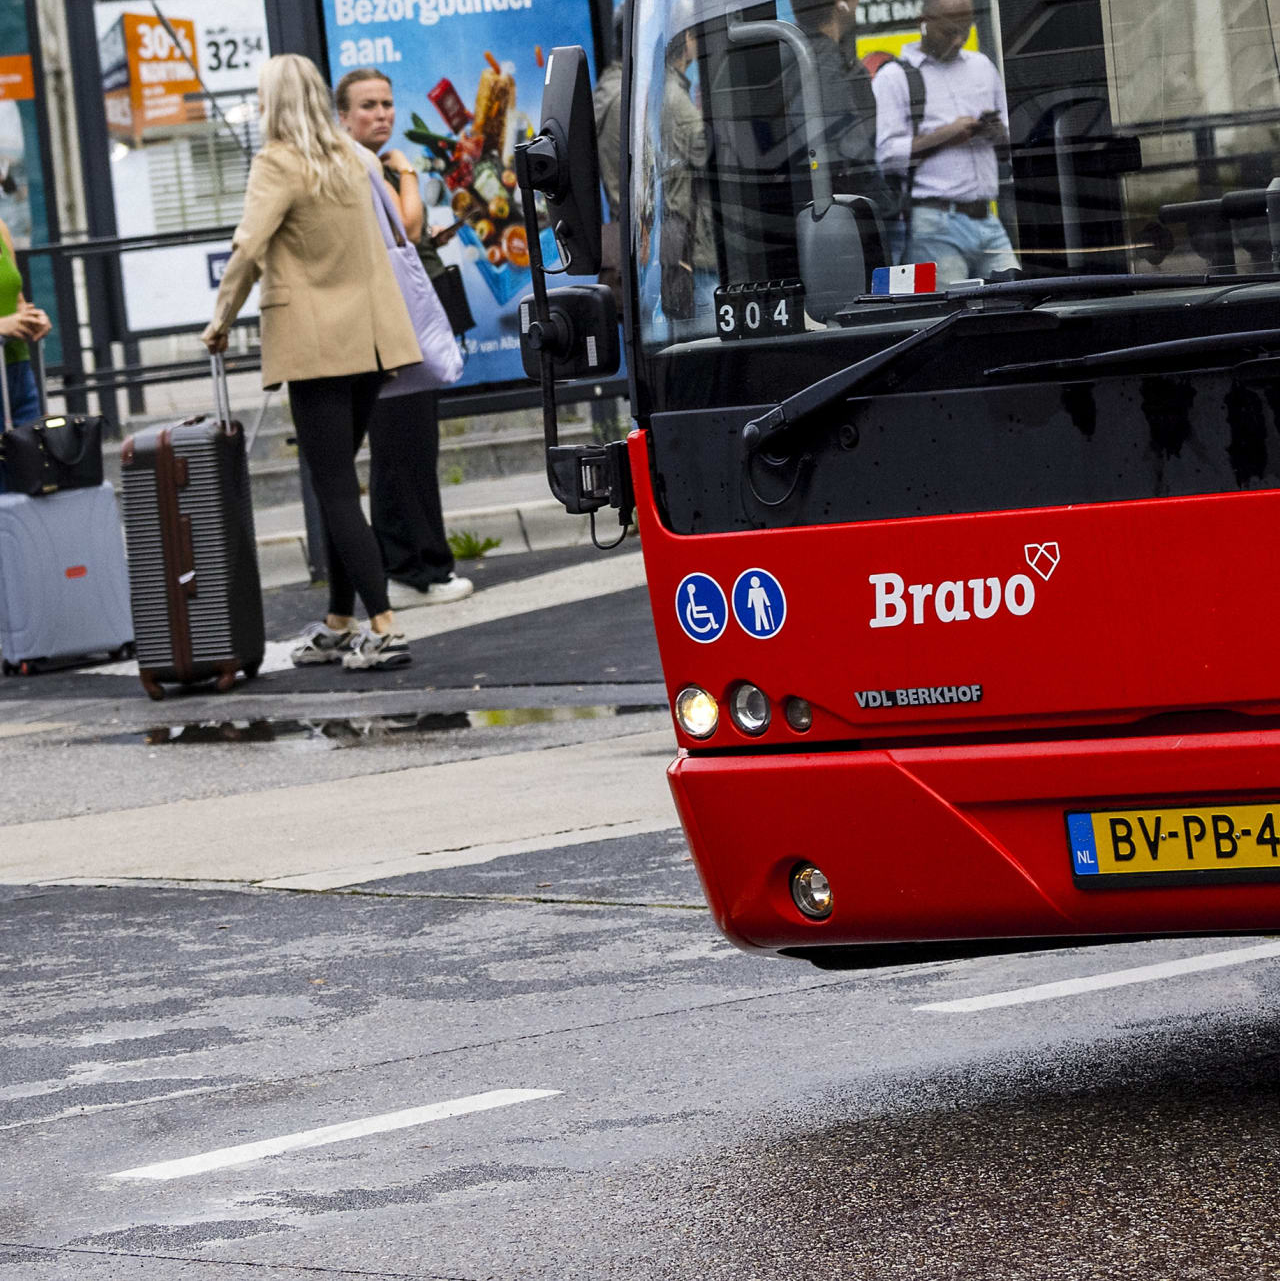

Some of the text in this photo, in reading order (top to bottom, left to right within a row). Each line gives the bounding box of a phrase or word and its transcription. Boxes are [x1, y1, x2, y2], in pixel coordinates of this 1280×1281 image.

[338, 37, 402, 68] aan.
[869, 573, 1035, 629] Bravo
[854, 685, 982, 709] VDL BERKHOF
[1077, 850, 1094, 864] NL
